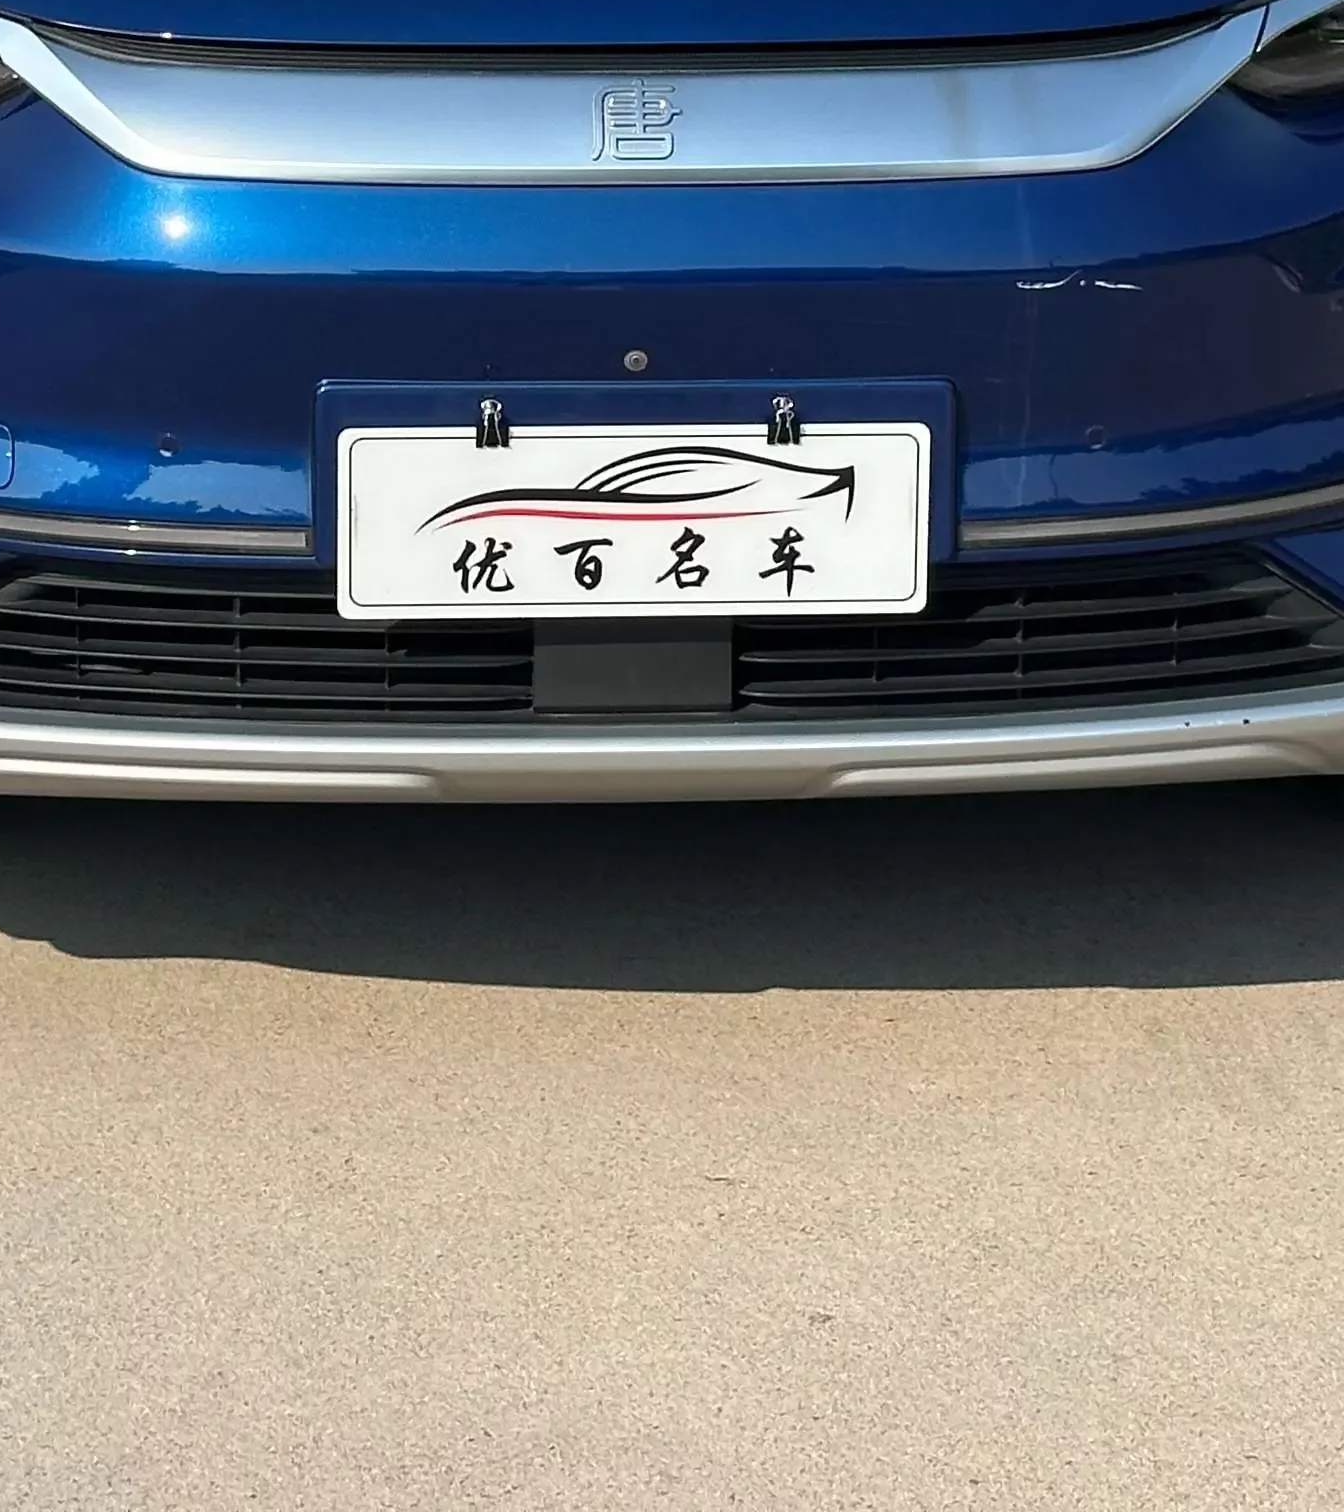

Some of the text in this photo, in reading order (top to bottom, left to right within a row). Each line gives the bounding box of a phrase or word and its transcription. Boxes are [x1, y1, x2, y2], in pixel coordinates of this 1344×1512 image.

[592, 77, 683, 161] 唐
[452, 525, 815, 597] 优百名车
